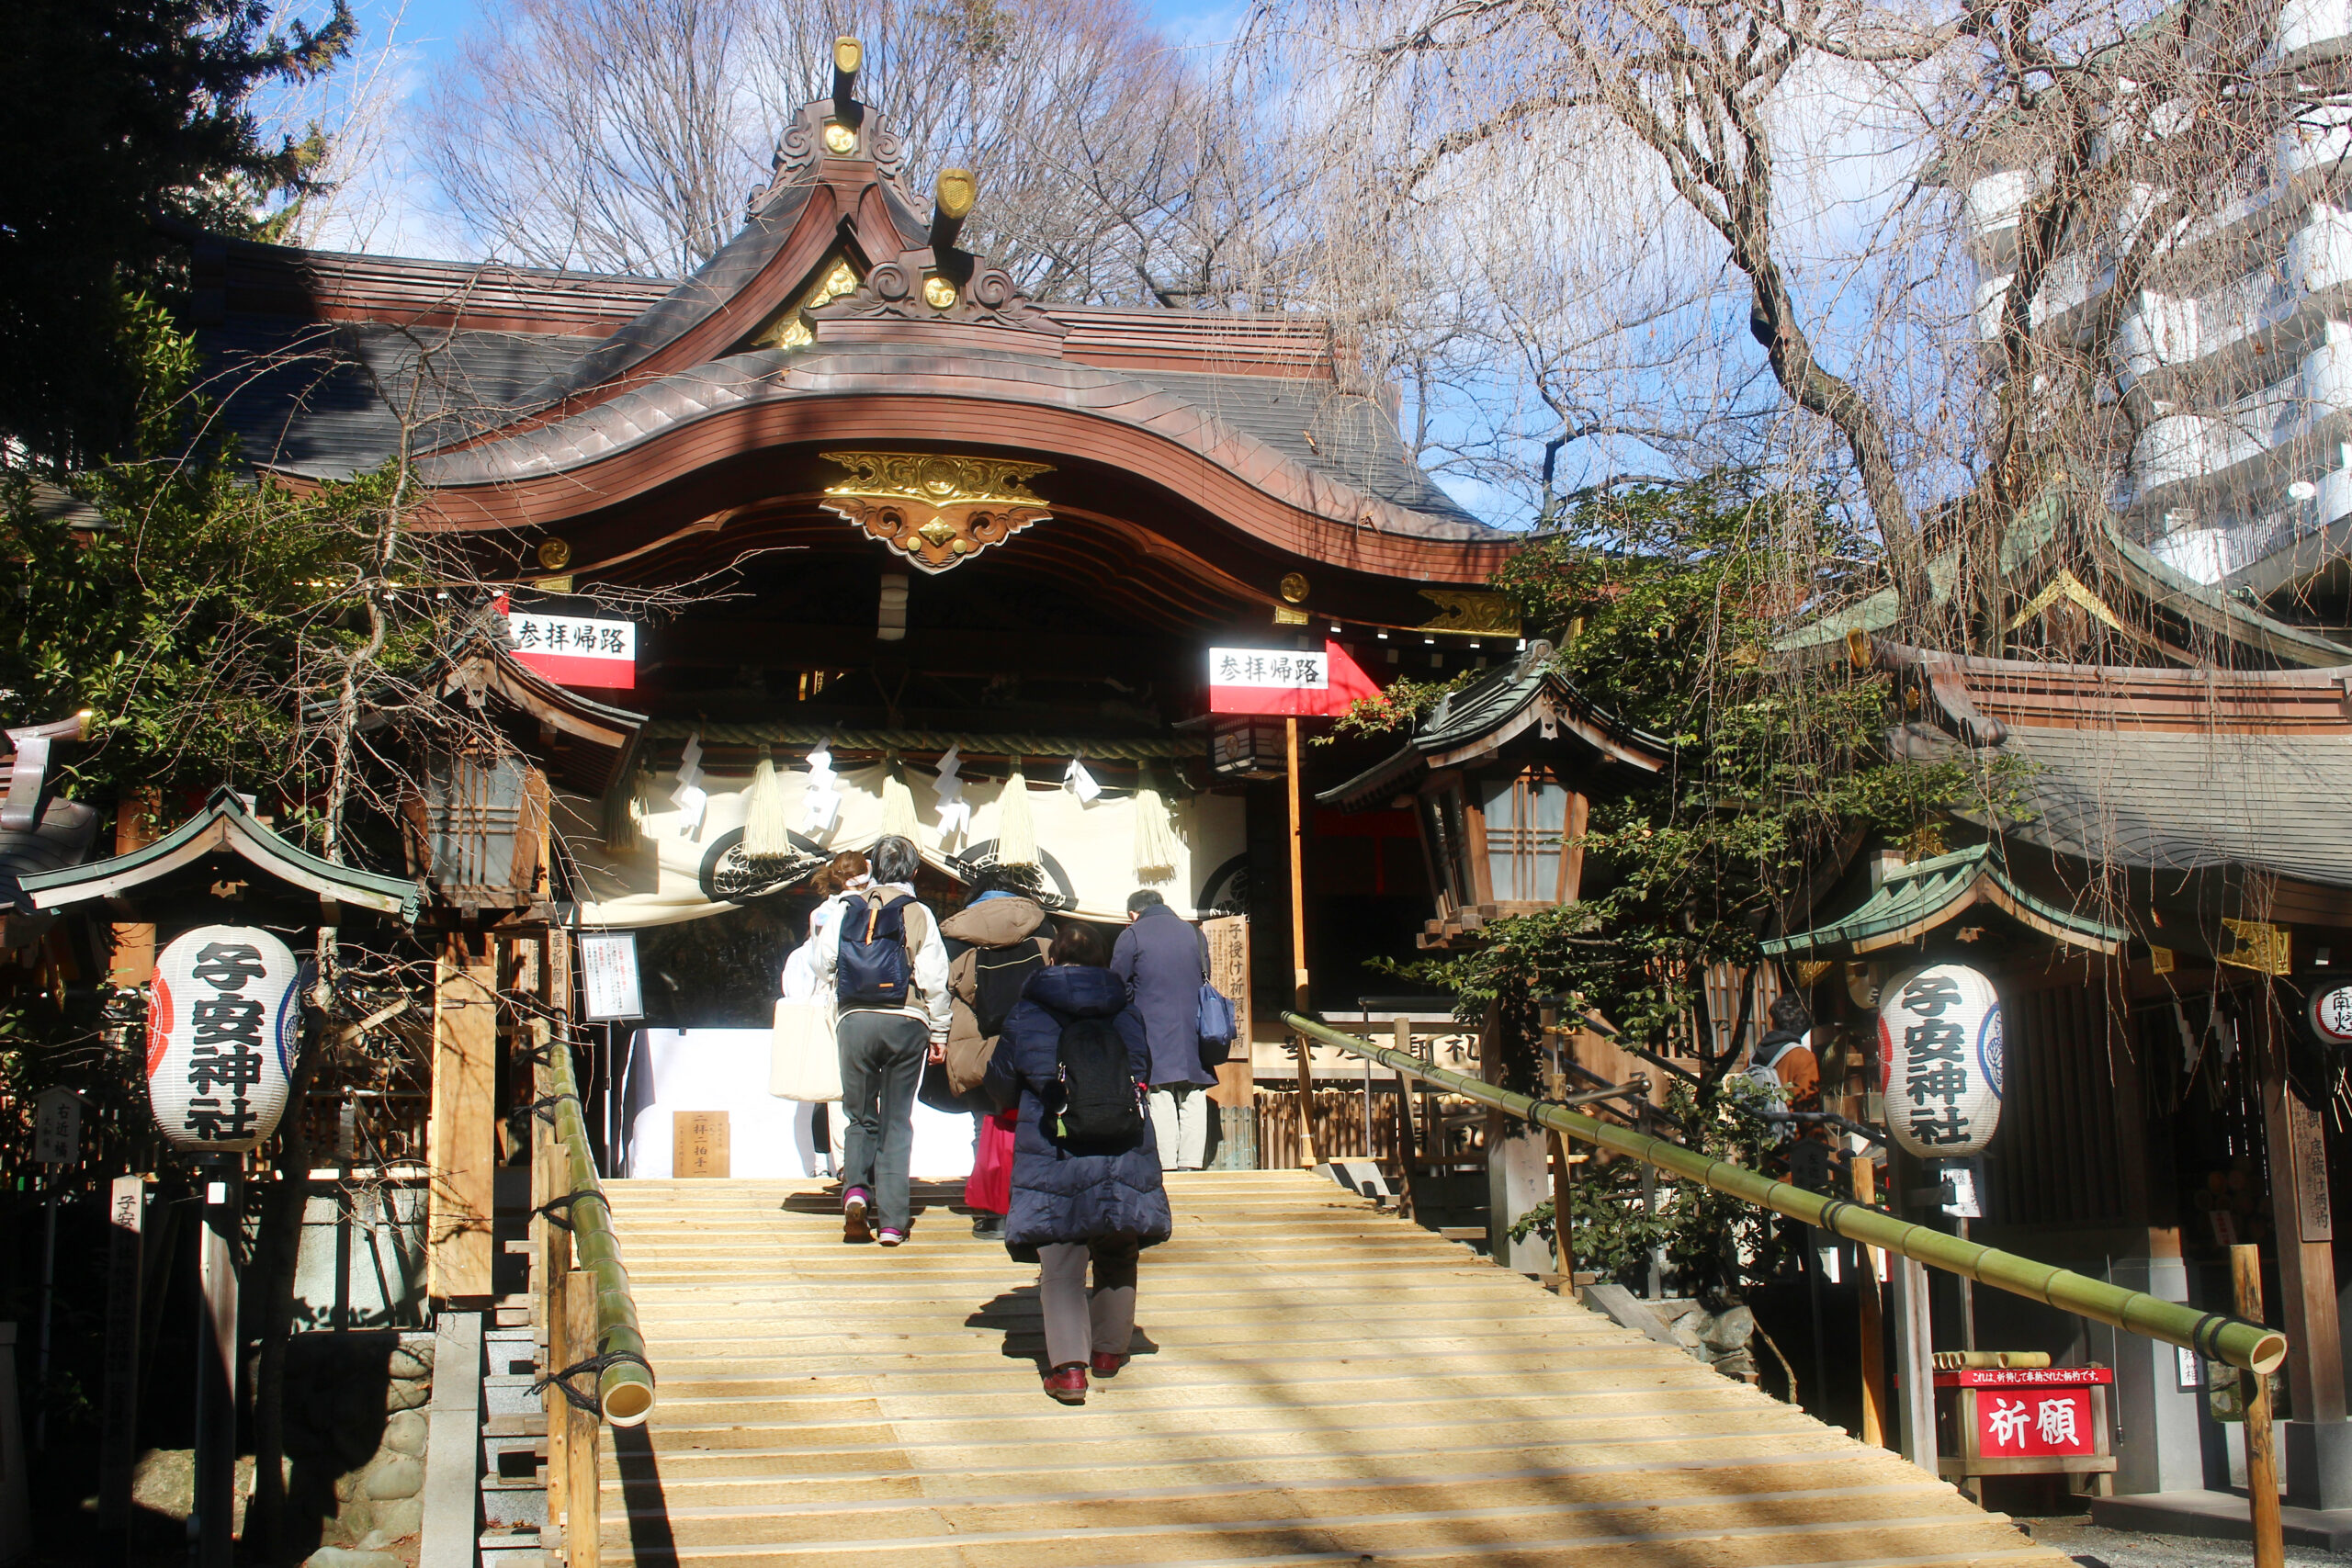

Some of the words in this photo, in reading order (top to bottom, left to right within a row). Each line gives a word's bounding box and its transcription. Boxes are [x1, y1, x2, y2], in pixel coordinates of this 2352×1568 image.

[519, 620, 626, 653] 参拝帰路
[1220, 655, 1319, 682] 参拝帰路
[185, 942, 266, 1141] 子安神社
[1902, 976, 1972, 1145] 子安神社
[693, 1115, 708, 1173] 二拝二拍手一
[1988, 1398, 2080, 1449] 祈願
